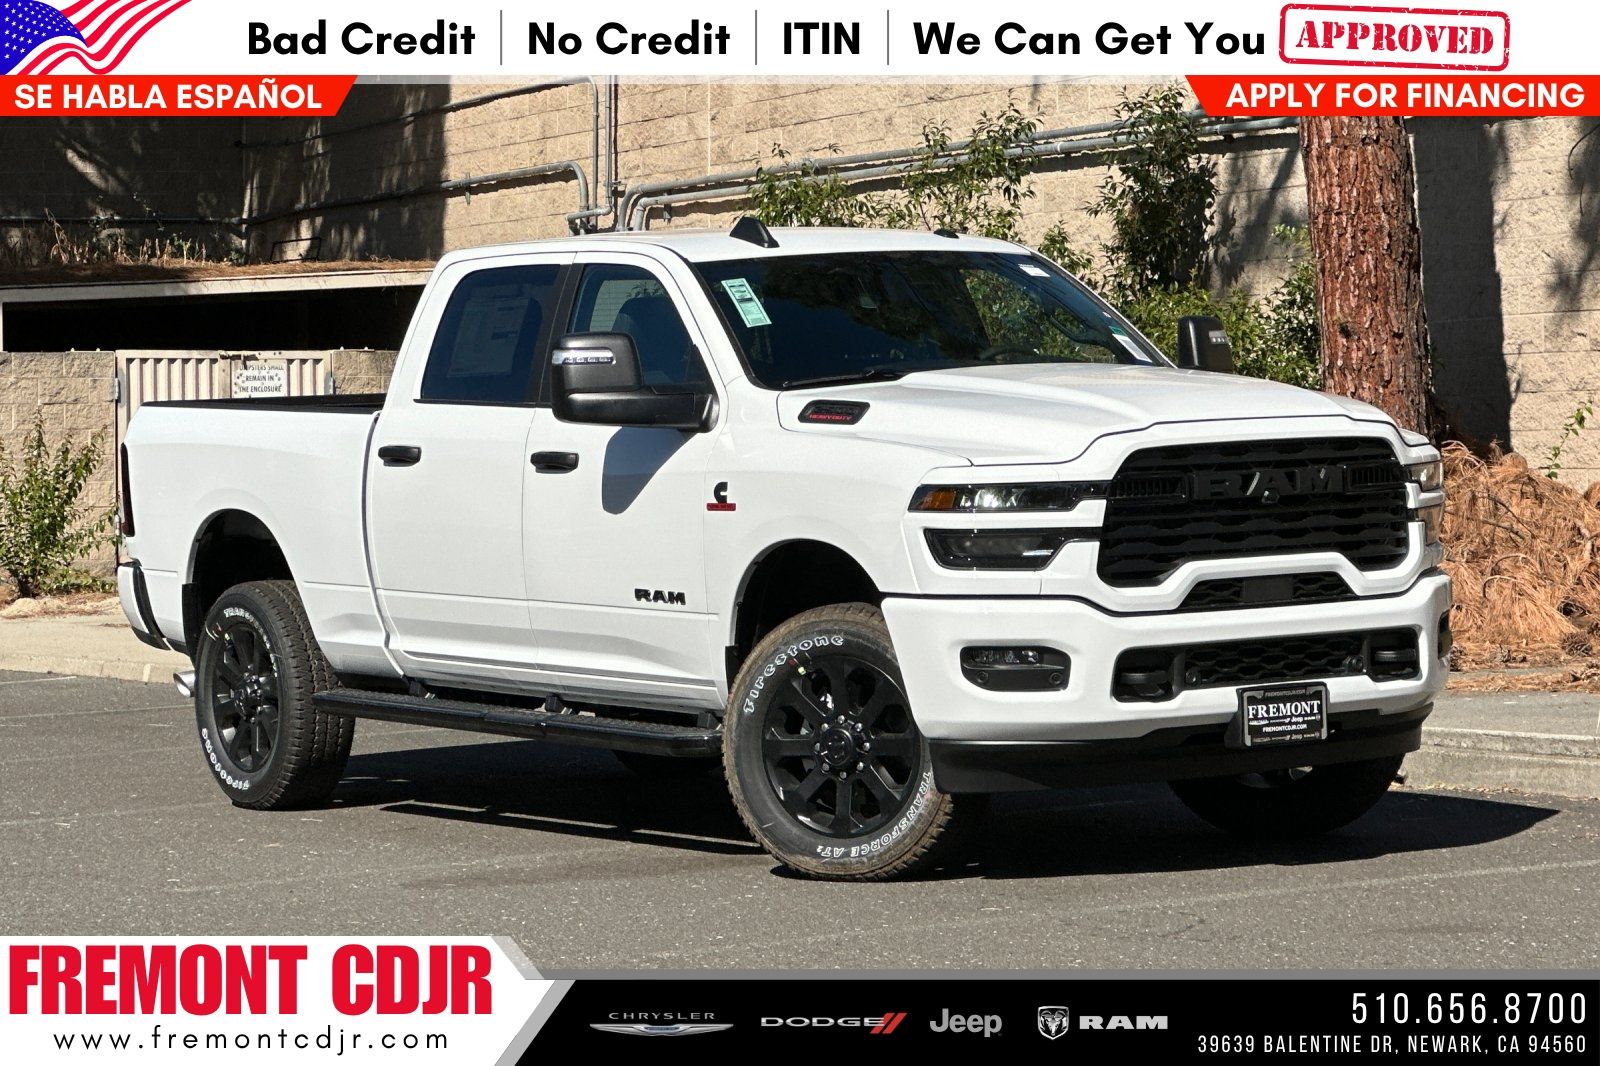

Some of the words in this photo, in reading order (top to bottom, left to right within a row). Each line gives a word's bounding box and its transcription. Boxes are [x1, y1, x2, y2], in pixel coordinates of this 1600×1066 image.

[1194, 465, 1344, 500] RAM
[634, 588, 686, 606] RAM
[1248, 700, 1320, 718] FREMONT
[849, 771, 932, 857] TRANSFORCE
